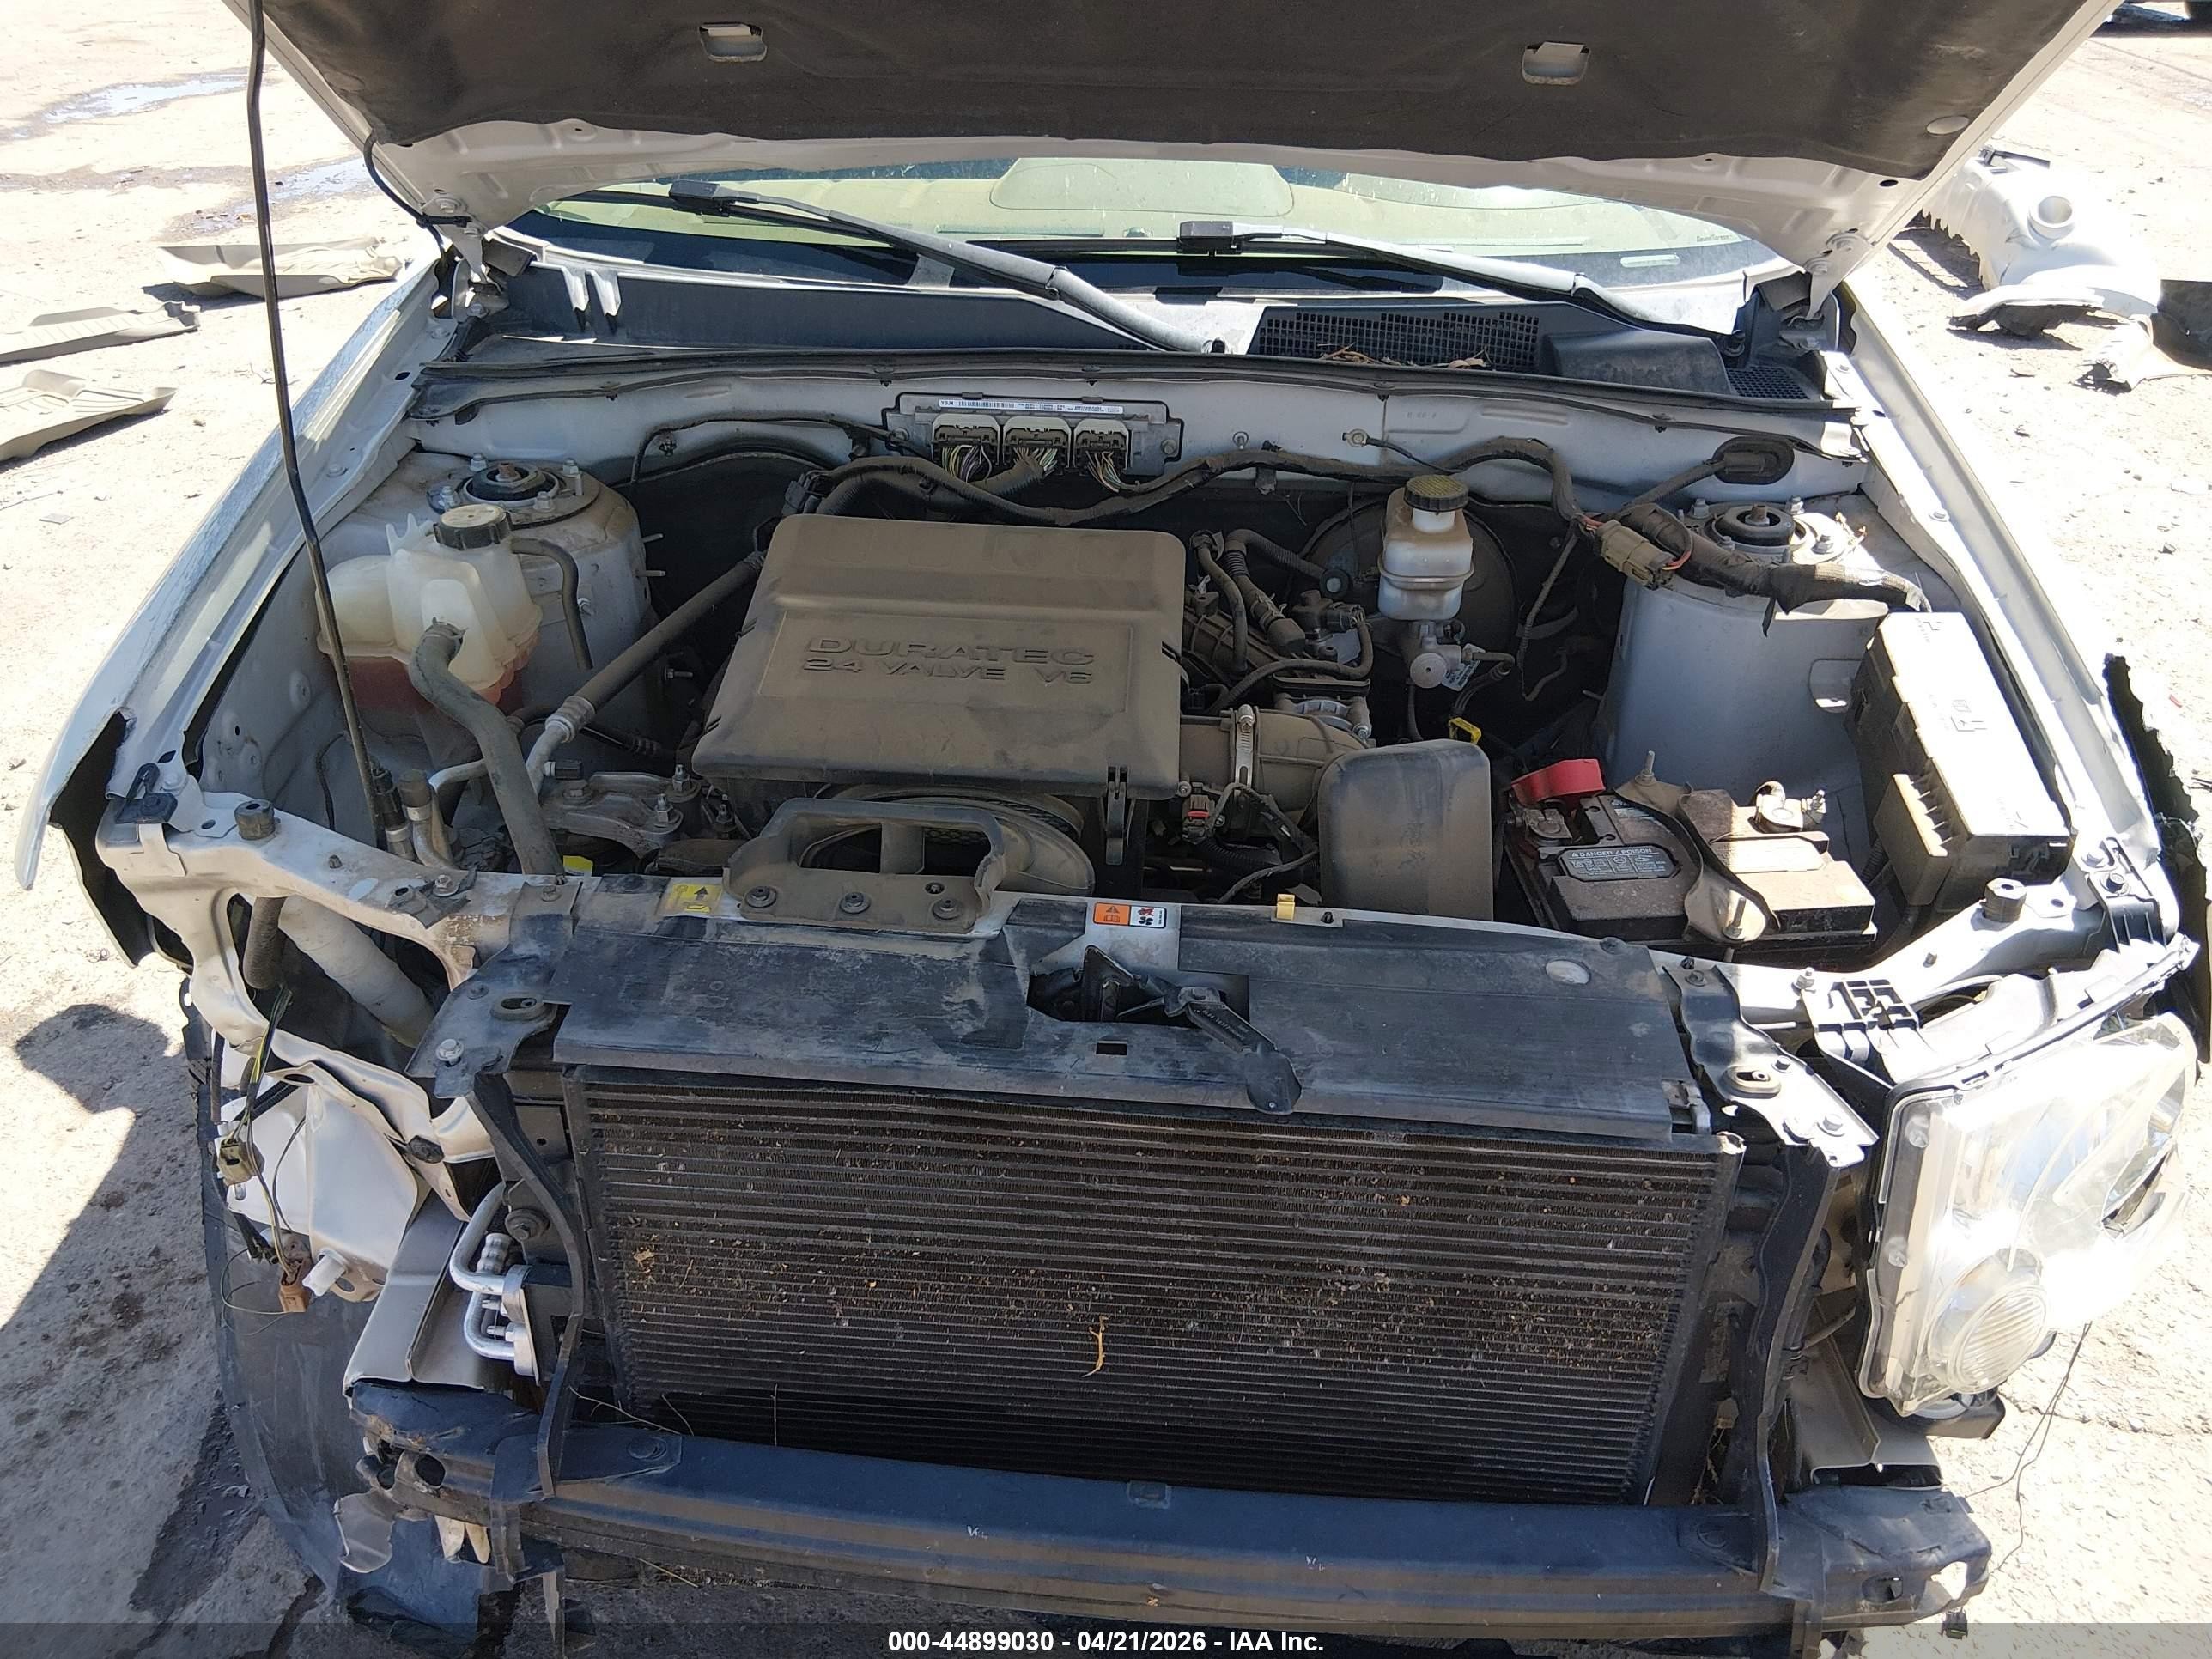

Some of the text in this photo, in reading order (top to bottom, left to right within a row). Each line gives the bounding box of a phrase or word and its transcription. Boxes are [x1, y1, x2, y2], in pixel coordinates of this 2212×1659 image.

[805, 637, 1095, 666] DURATEC
[802, 657, 1094, 684] 24 VALVE V6
